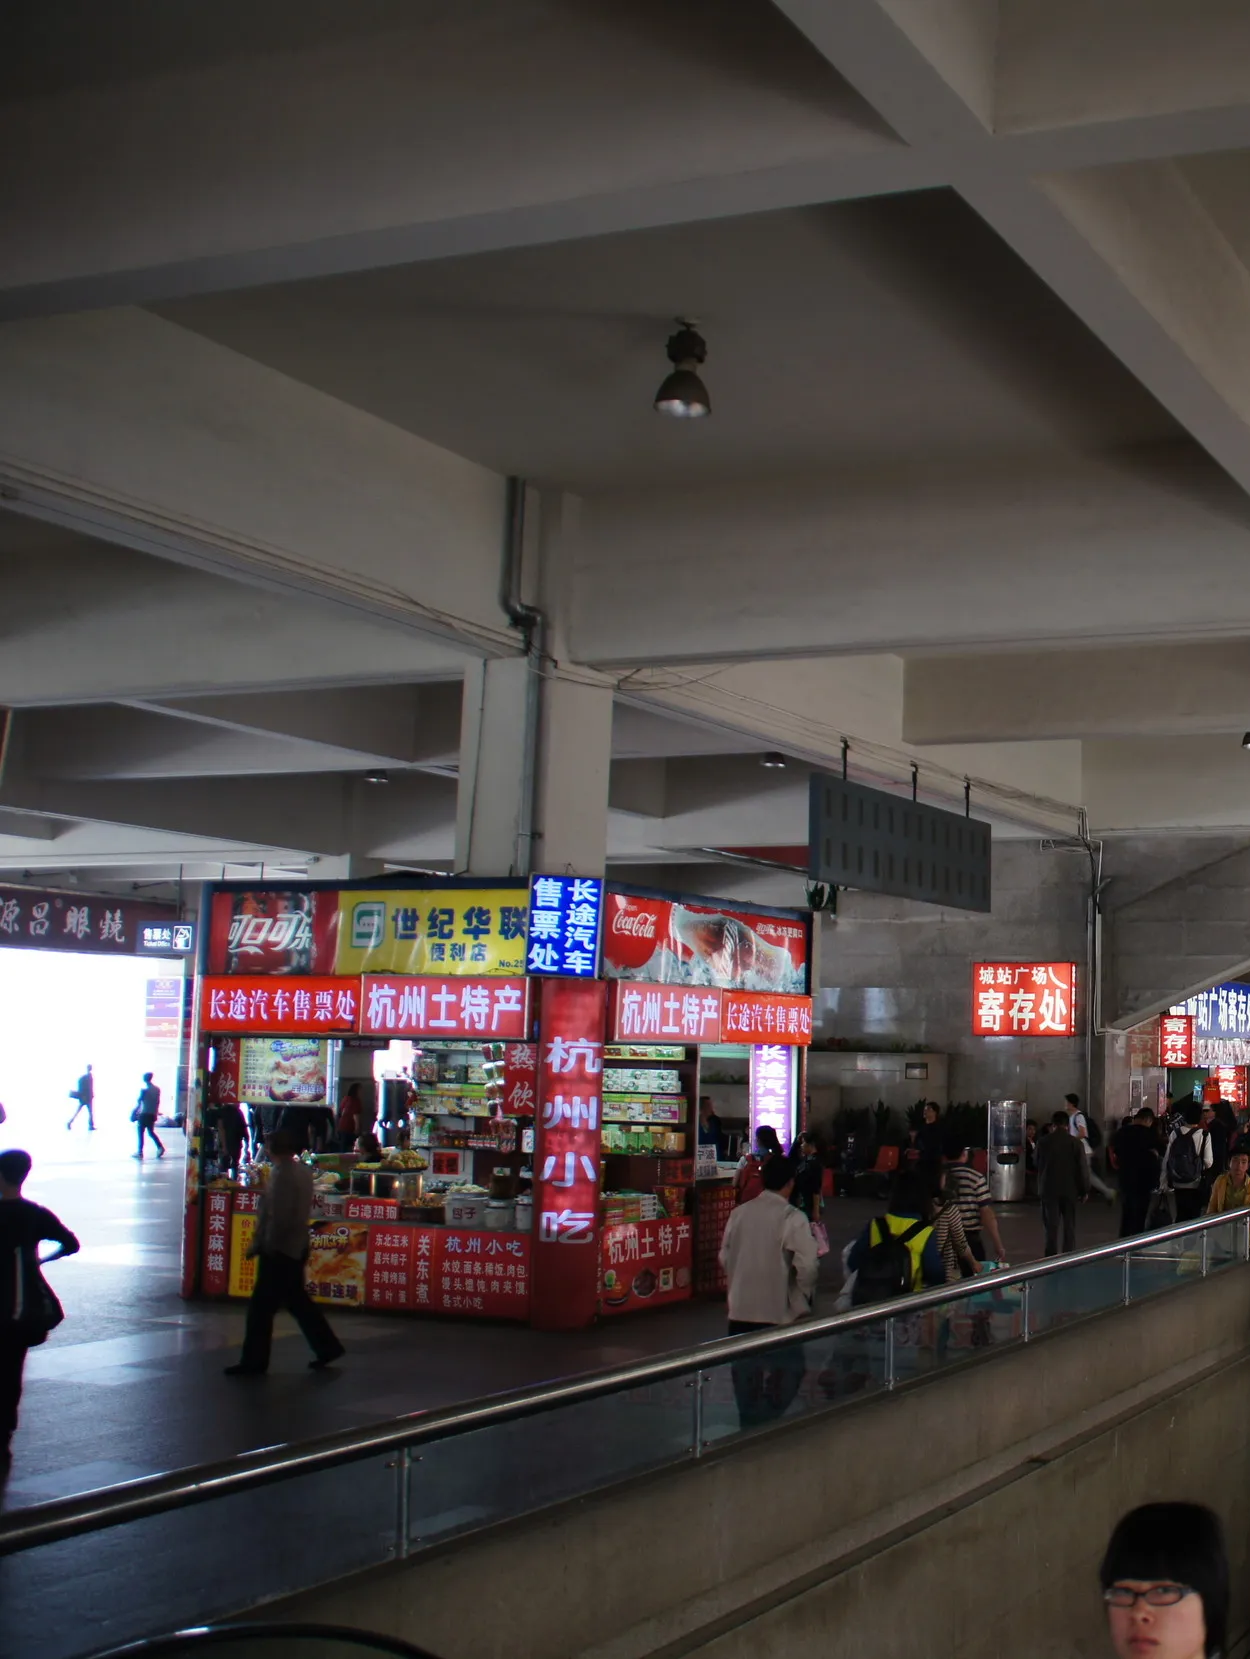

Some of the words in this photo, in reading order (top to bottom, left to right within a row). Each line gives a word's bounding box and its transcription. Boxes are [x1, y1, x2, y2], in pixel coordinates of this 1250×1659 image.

[228, 910, 313, 952] 可口可乐
[391, 906, 527, 941] 世纪华联
[528, 878, 563, 972] 售票处
[562, 879, 598, 974] 长途汽车
[430, 942, 487, 962] 便利店
[208, 988, 355, 1021] 长途汽车售票处
[367, 983, 522, 1031] 杭州土特产
[621, 989, 718, 1036] 杭州土特产
[726, 1002, 811, 1033] 长途汽车售票处
[978, 988, 1068, 1031] 寄存处
[1163, 1018, 1188, 1065] 寄存处
[539, 1036, 602, 1244] 杭州小吃
[348, 1204, 397, 1220] 台湾热狗
[452, 1207, 477, 1220] 包子
[375, 1233, 409, 1248] 东北玉米
[445, 1236, 524, 1257] 杭州小吃
[607, 1221, 690, 1265] 杭州土特产
[416, 1235, 430, 1304] 关东煮
[443, 1294, 483, 1310] 各式小吃
